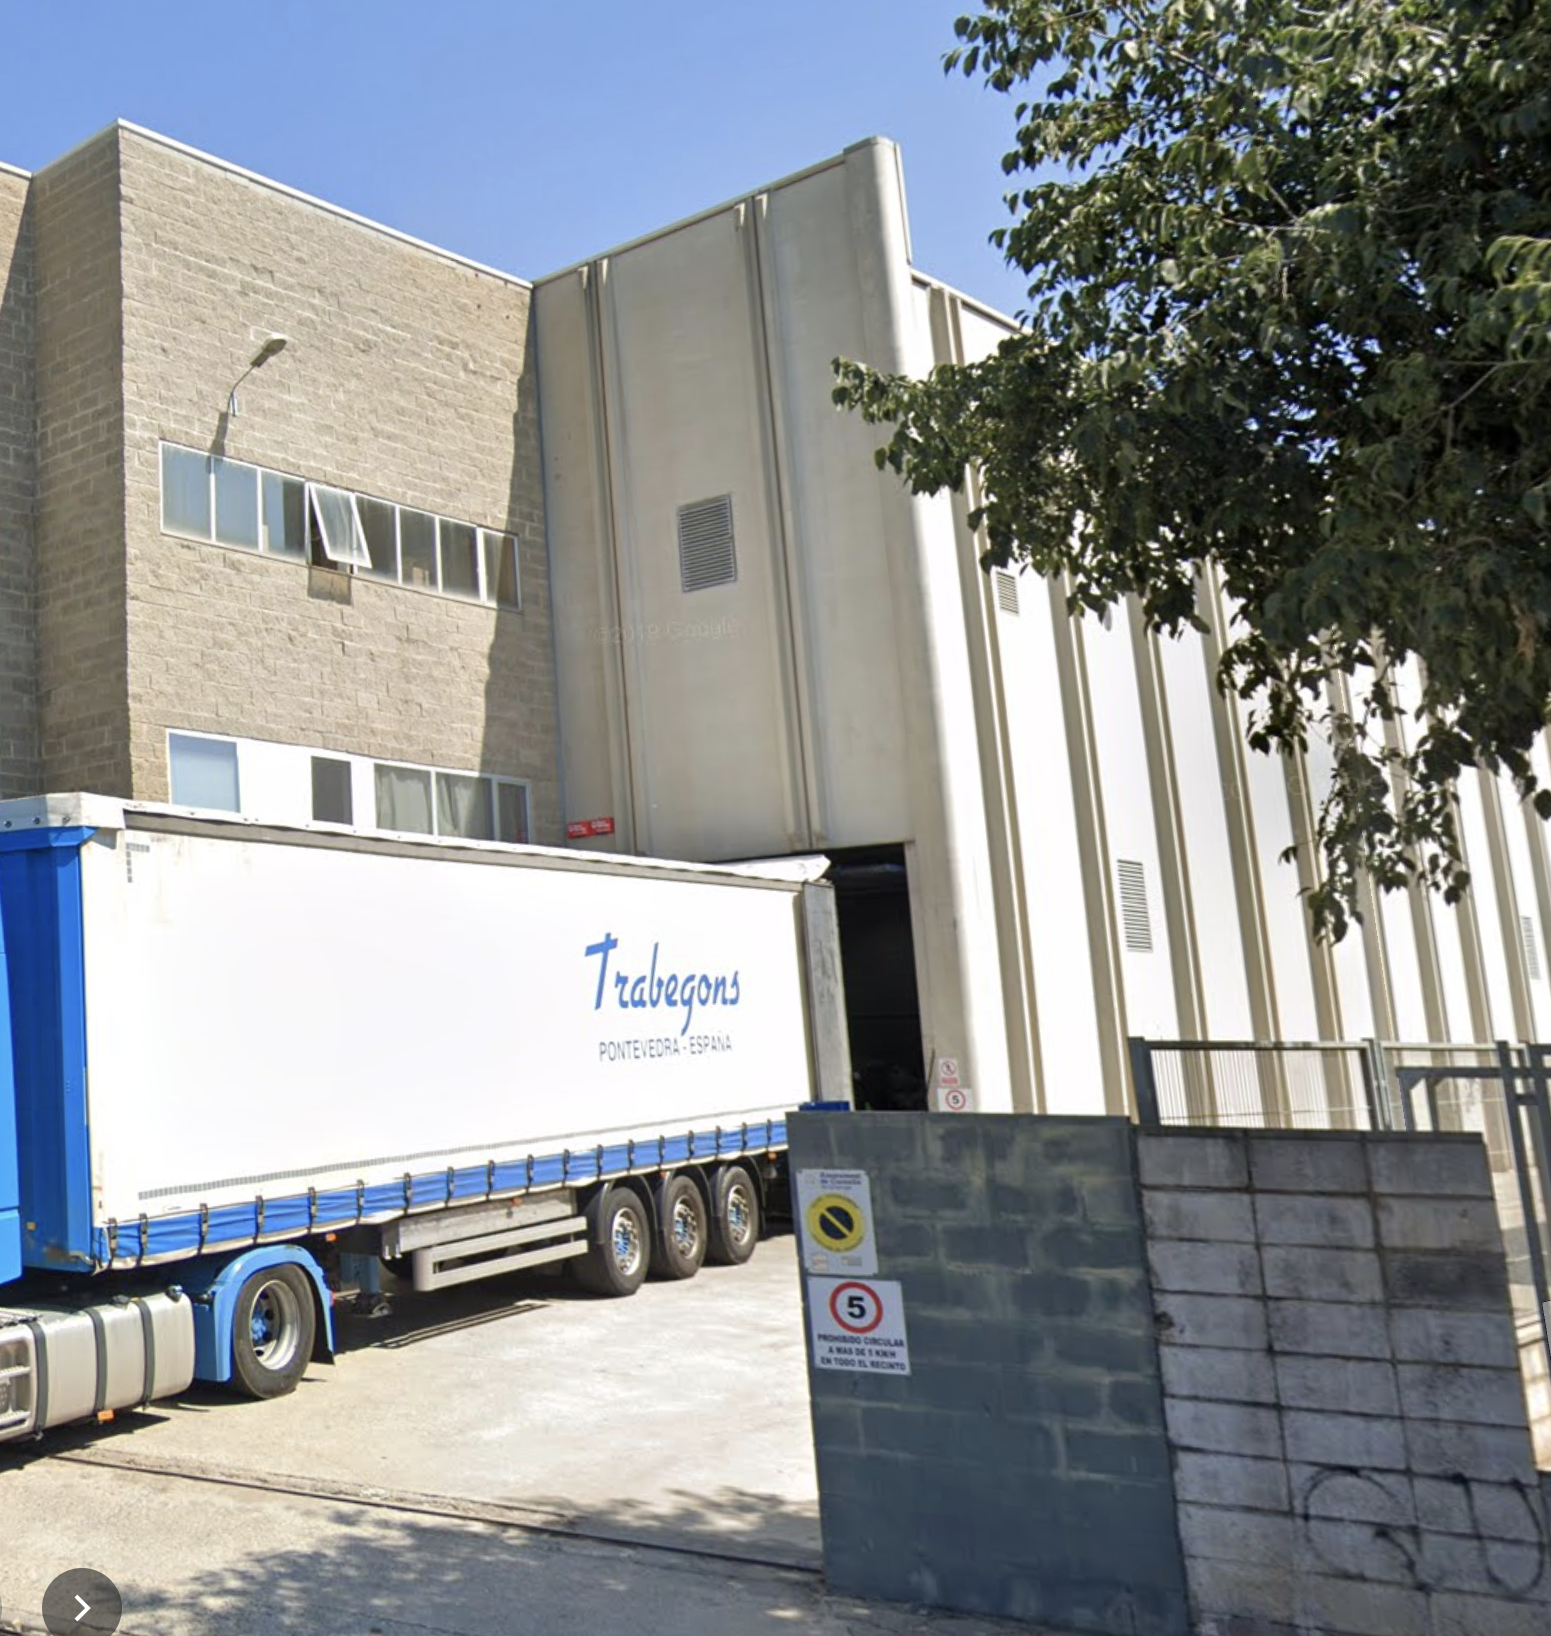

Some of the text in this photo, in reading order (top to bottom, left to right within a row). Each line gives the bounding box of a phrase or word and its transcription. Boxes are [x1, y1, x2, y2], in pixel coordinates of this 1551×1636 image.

[584, 932, 740, 1037] Trabegons
[599, 1037, 680, 1062] PONTEVEDRA
[689, 1031, 732, 1055] ESPAÑA
[848, 1295, 866, 1319] 5
[817, 1333, 904, 1347] PROHIBIDO CIRCULAR
[855, 1348, 866, 1356] DE
[820, 1356, 906, 1371] EN TODO EL RECINTO
